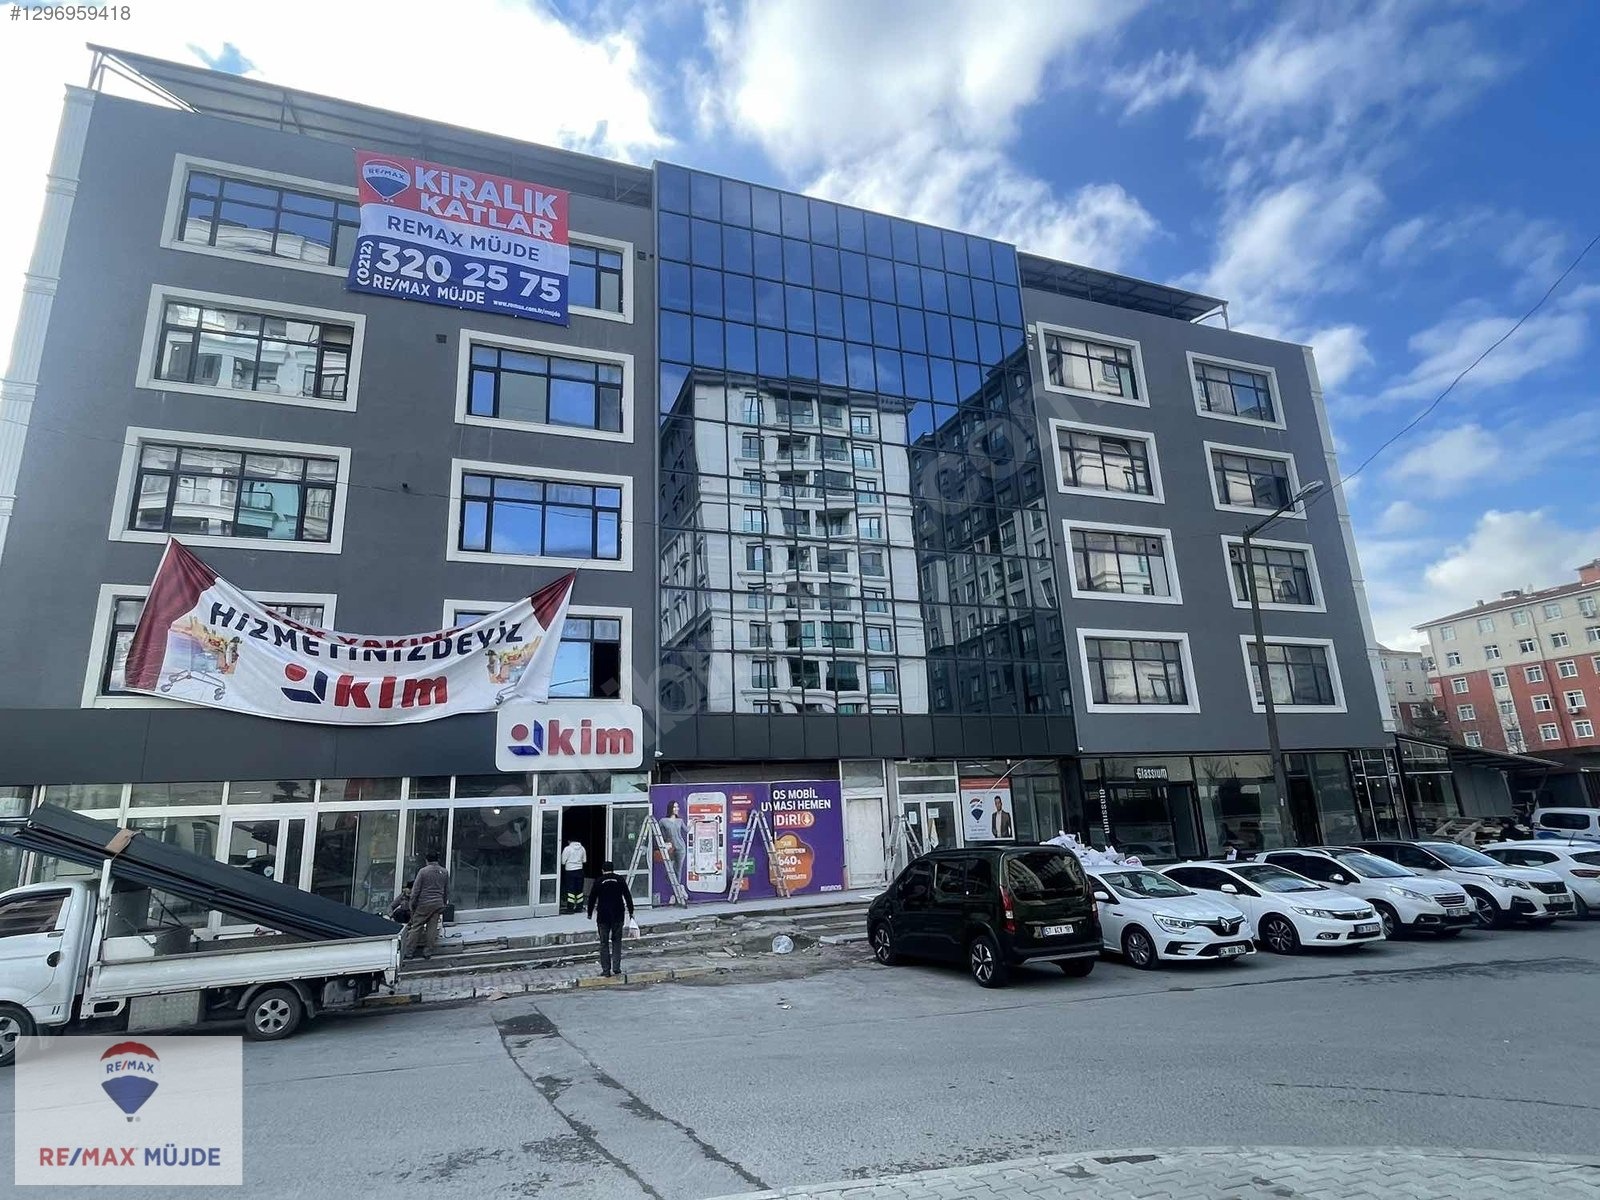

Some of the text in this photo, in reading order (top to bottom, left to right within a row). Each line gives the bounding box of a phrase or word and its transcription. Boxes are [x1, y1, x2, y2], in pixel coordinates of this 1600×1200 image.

[368, 168, 405, 181] RE/MAX
[420, 193, 554, 240] KATLAR
[387, 215, 540, 262] REMAX MÜJDE
[356, 240, 375, 286] (0212)
[375, 242, 561, 302] 320 25 75
[373, 274, 485, 305] RE/MAX MÜJDE
[547, 719, 634, 755] kim
[797, 799, 831, 810] HEMEN
